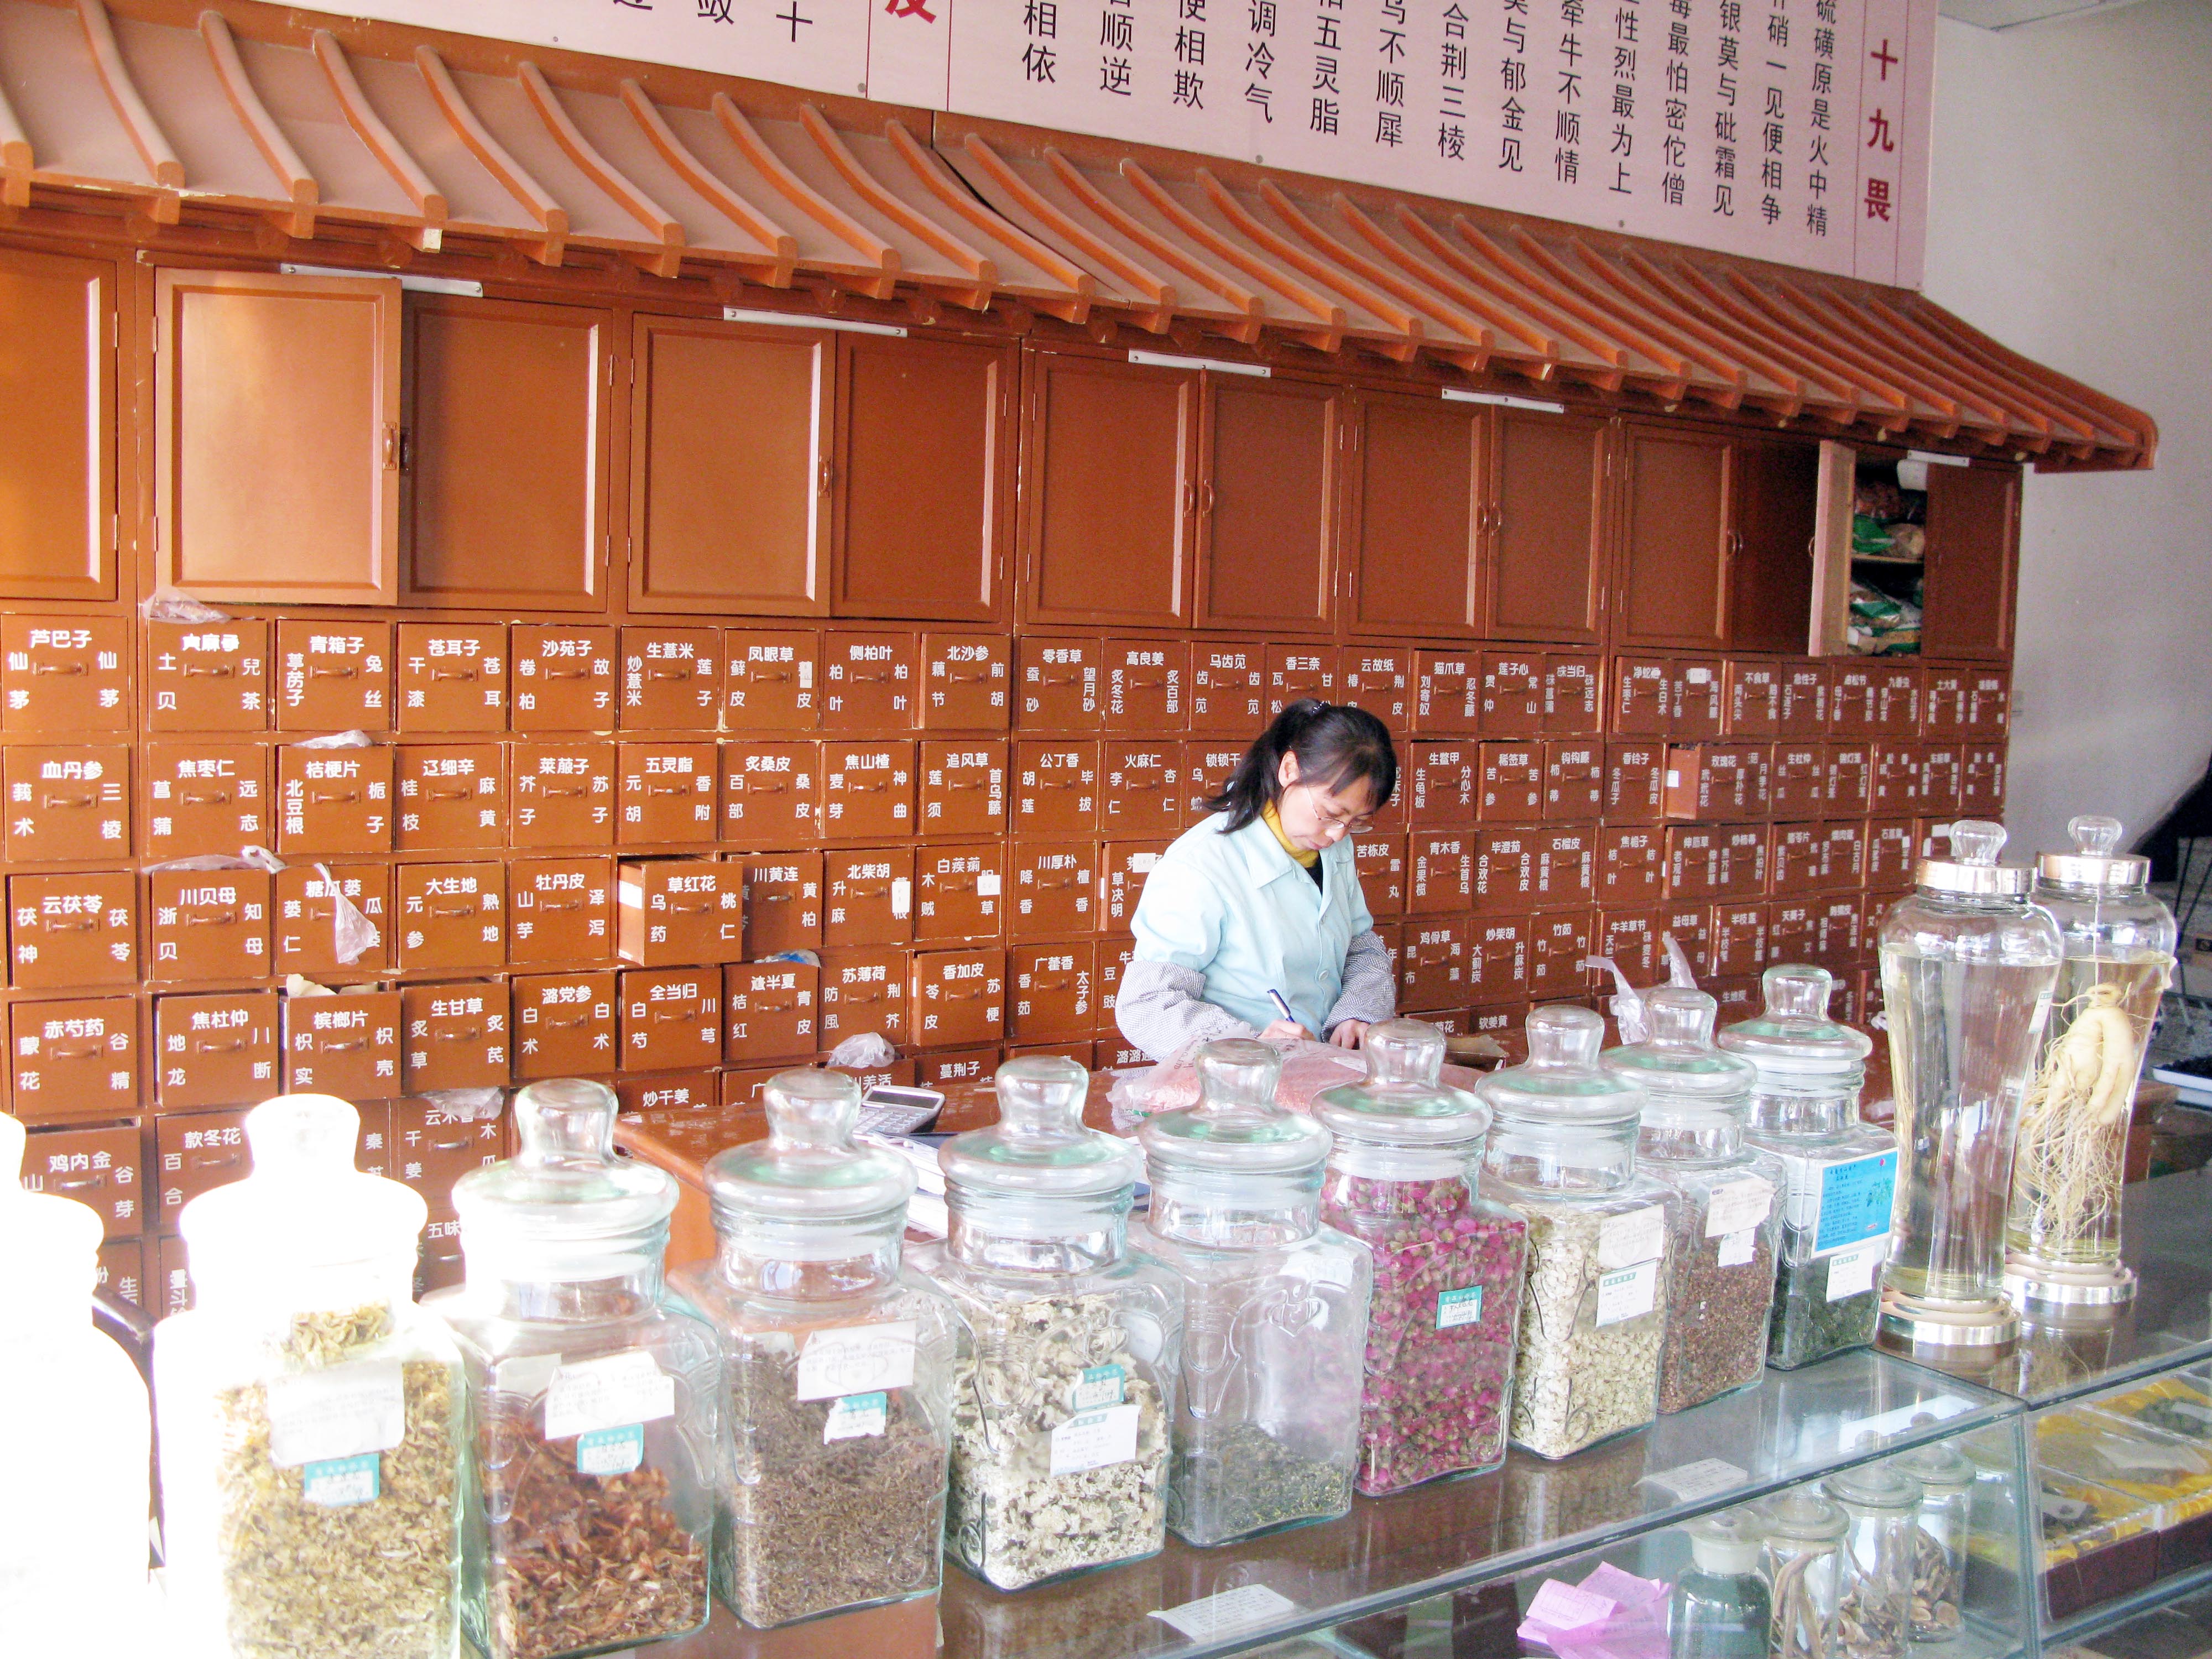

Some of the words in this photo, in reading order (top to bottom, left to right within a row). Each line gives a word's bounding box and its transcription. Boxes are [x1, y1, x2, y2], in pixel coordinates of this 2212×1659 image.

[776, 1, 813, 43] 十
[1100, 0, 1134, 96] 顺逆
[1244, 0, 1276, 124] 调冷气
[1438, 2, 1469, 161] 合荆三棱
[1609, 0, 1639, 195] 性烈最为上
[1714, 0, 1741, 217] 银莫与砒霜见
[1864, 38, 1898, 222] 十九畏
[29, 629, 92, 648] 芦巴子
[428, 639, 481, 656] 苍耳子
[542, 640, 592, 657] 沙苑子
[646, 642, 694, 659] 生薏米
[748, 646, 794, 662] 凤眼草
[849, 645, 893, 661] 侧柏叶
[947, 645, 989, 661] 北沙参
[1042, 649, 1082, 664] 零香草
[1126, 651, 1164, 666] 高良姜
[1361, 659, 1394, 672] 云故纸
[1434, 662, 1465, 675] 猫爪草
[1498, 662, 1528, 675] 莲子心
[627, 656, 643, 706] 炒薏米
[1083, 667, 1096, 712] 望月砂
[1110, 669, 1124, 714] 炙冬花
[1166, 670, 1179, 713] 炙百部
[1419, 675, 1431, 716] 刘寄奴
[178, 759, 235, 779] 焦枣仁
[305, 760, 360, 779] 桔梗片
[423, 758, 474, 776] 辽细辛
[645, 757, 693, 774] 五灵脂
[745, 756, 790, 772] 炙桑皮
[845, 753, 890, 770] 焦山楂
[946, 752, 988, 768] 追风草
[1040, 753, 1079, 768] 公丁香
[1124, 753, 1161, 768] 火麻仁
[41, 761, 102, 780] 血丹参
[988, 768, 1002, 815] 首乌藤
[1459, 765, 1472, 805] 分心木
[285, 779, 304, 834] 北豆根
[1430, 841, 1460, 855] 青木香
[847, 863, 890, 879] 北柴胡
[1038, 854, 1077, 869] 川厚朴
[754, 866, 799, 883] 川黄连
[1459, 855, 1470, 894] 生首乌
[1477, 854, 1489, 894] 合欢花
[1519, 853, 1531, 891] 合欢皮
[426, 877, 477, 895] 大生地
[536, 873, 585, 891] 牡丹皮
[667, 875, 716, 894] 草红花
[180, 887, 236, 905] 川贝母
[1111, 872, 1124, 917] 草决明
[43, 895, 102, 914] 云茯苓
[1420, 930, 1451, 945] 鸡骨草
[842, 966, 886, 984] 苏薄荷
[943, 962, 984, 980] 香加皮
[542, 985, 592, 1004] 潞党参
[650, 983, 697, 1001] 全当归
[1075, 970, 1089, 1015] 太子参
[431, 997, 483, 1016] 生甘草
[44, 1018, 104, 1039] 赤芍药
[191, 1009, 248, 1030] 焦杜仲
[314, 1010, 368, 1030] 槟榔片
[940, 1061, 980, 1079] 蔓荆子
[643, 1088, 689, 1107] 炒干姜
[48, 1151, 111, 1173] 鸡内金
